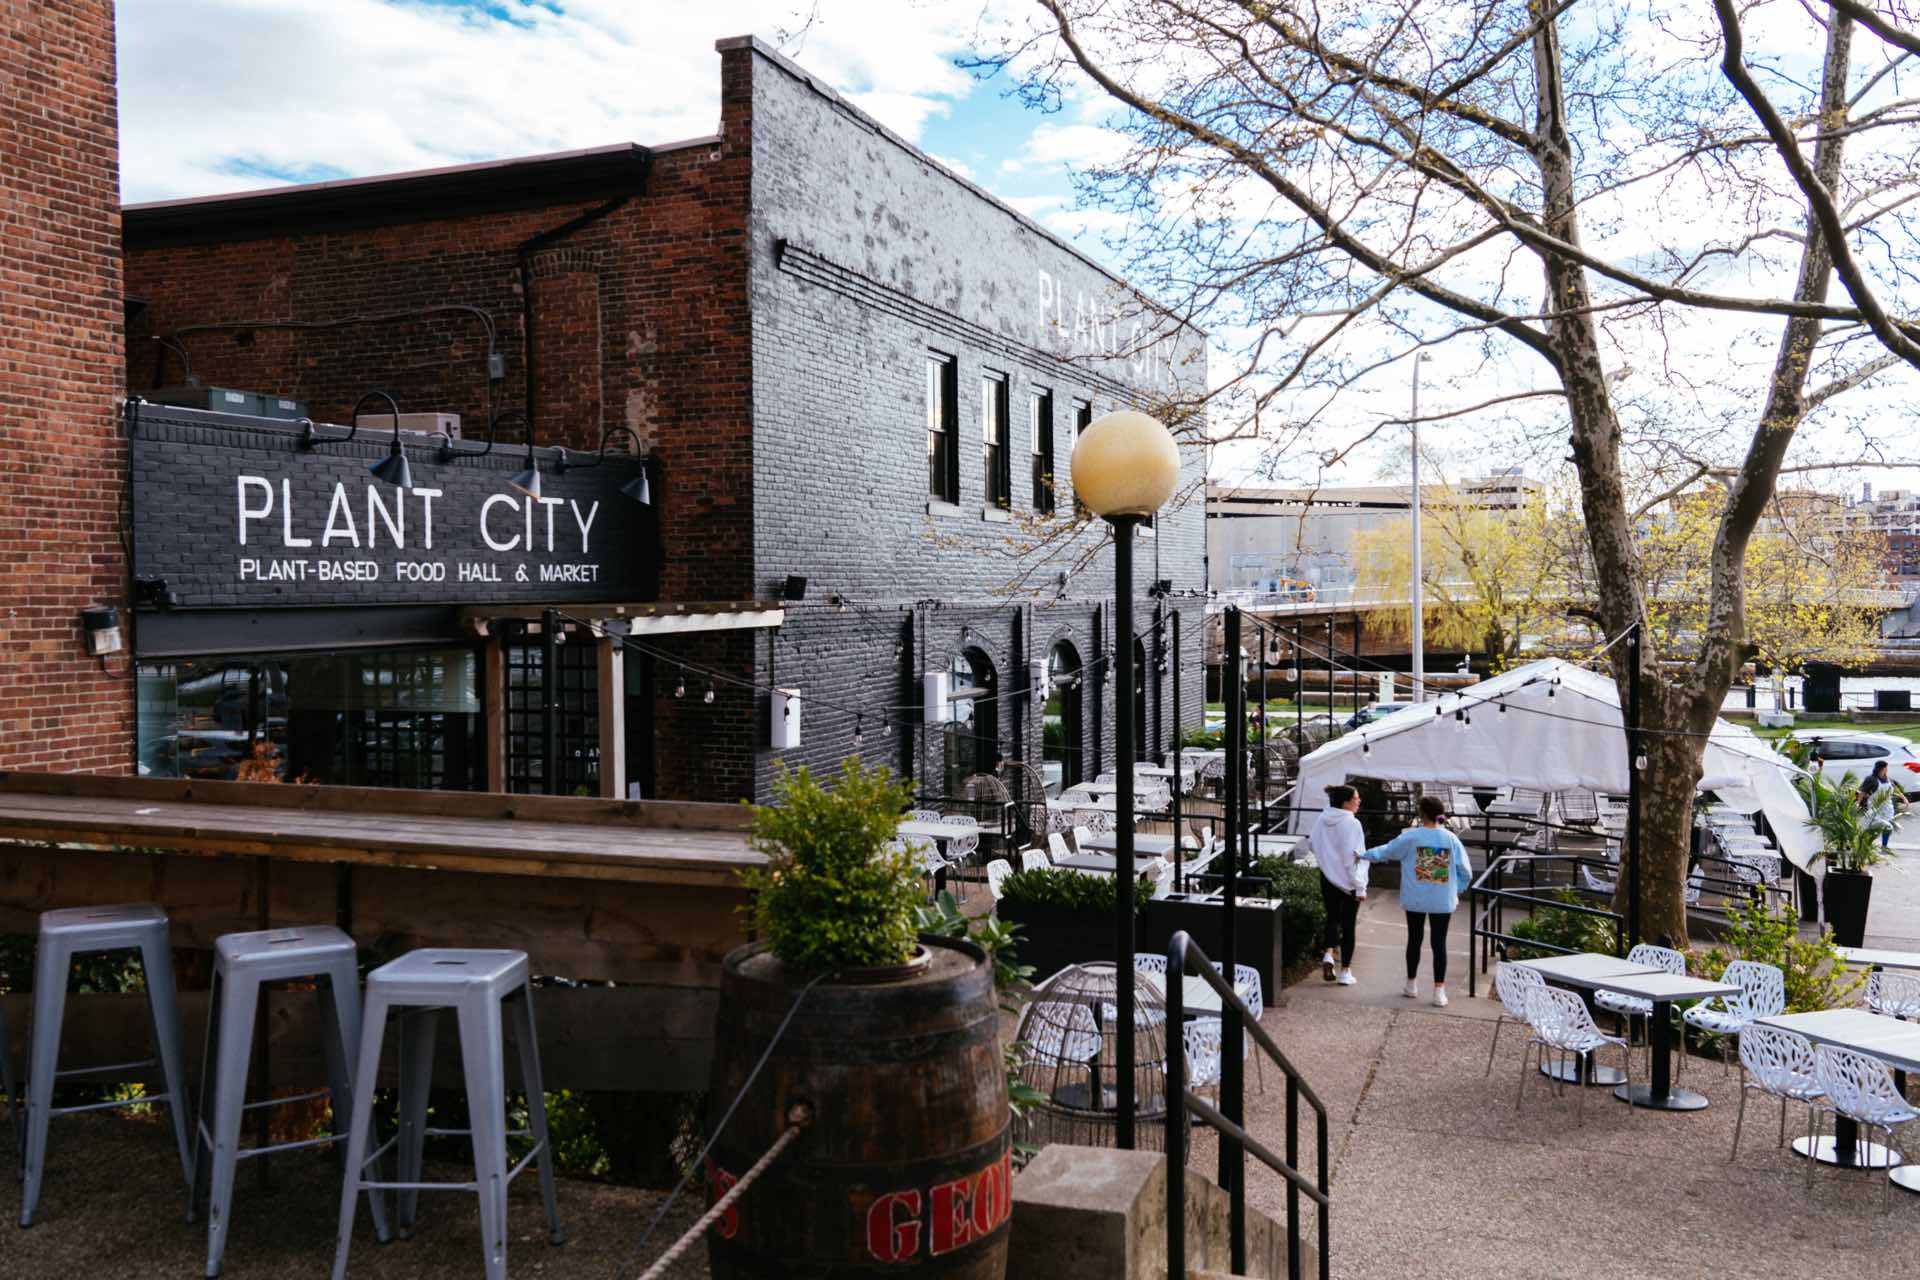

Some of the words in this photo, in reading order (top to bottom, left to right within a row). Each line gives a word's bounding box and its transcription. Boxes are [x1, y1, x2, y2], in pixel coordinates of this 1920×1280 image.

[1039, 269, 1122, 362] PLANT
[237, 475, 443, 550] PLANT
[480, 493, 599, 553] CITY
[240, 558, 379, 581] PLANT-BASED
[396, 561, 446, 582] FOOD
[458, 562, 502, 582] HALL
[515, 563, 530, 582] &
[540, 564, 599, 582] MARKET
[867, 1146, 1012, 1264] GEO
